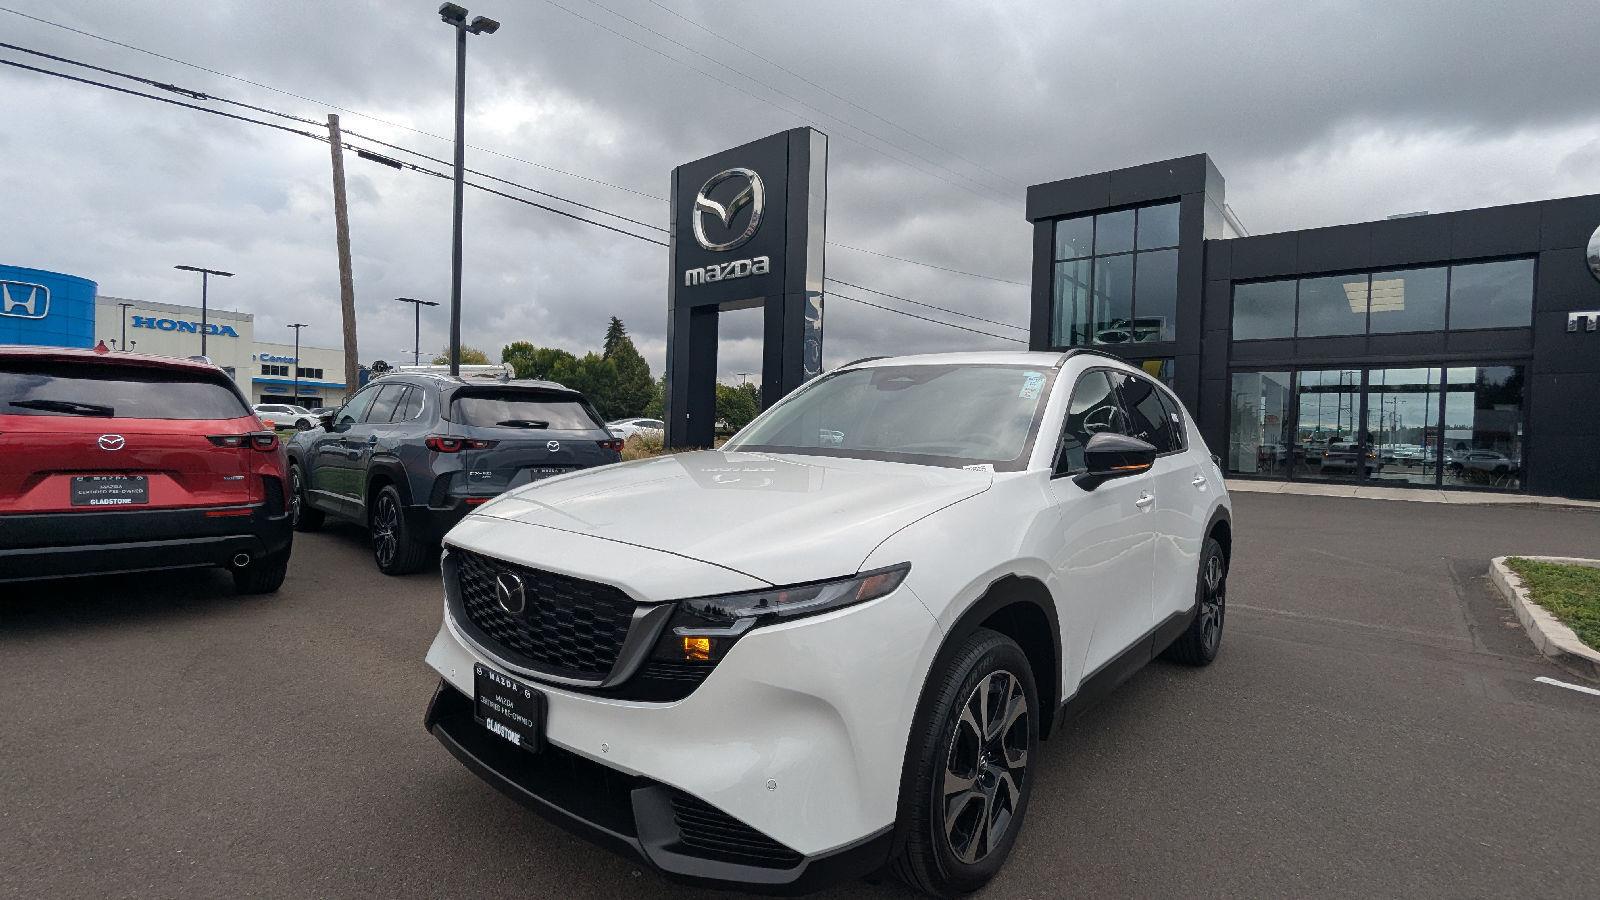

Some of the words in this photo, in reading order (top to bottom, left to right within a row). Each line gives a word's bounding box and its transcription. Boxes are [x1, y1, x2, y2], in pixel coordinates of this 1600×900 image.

[132, 315, 239, 337] HONDA
[489, 672, 518, 691] MAZDA
[486, 717, 521, 746] GLADSTONE
